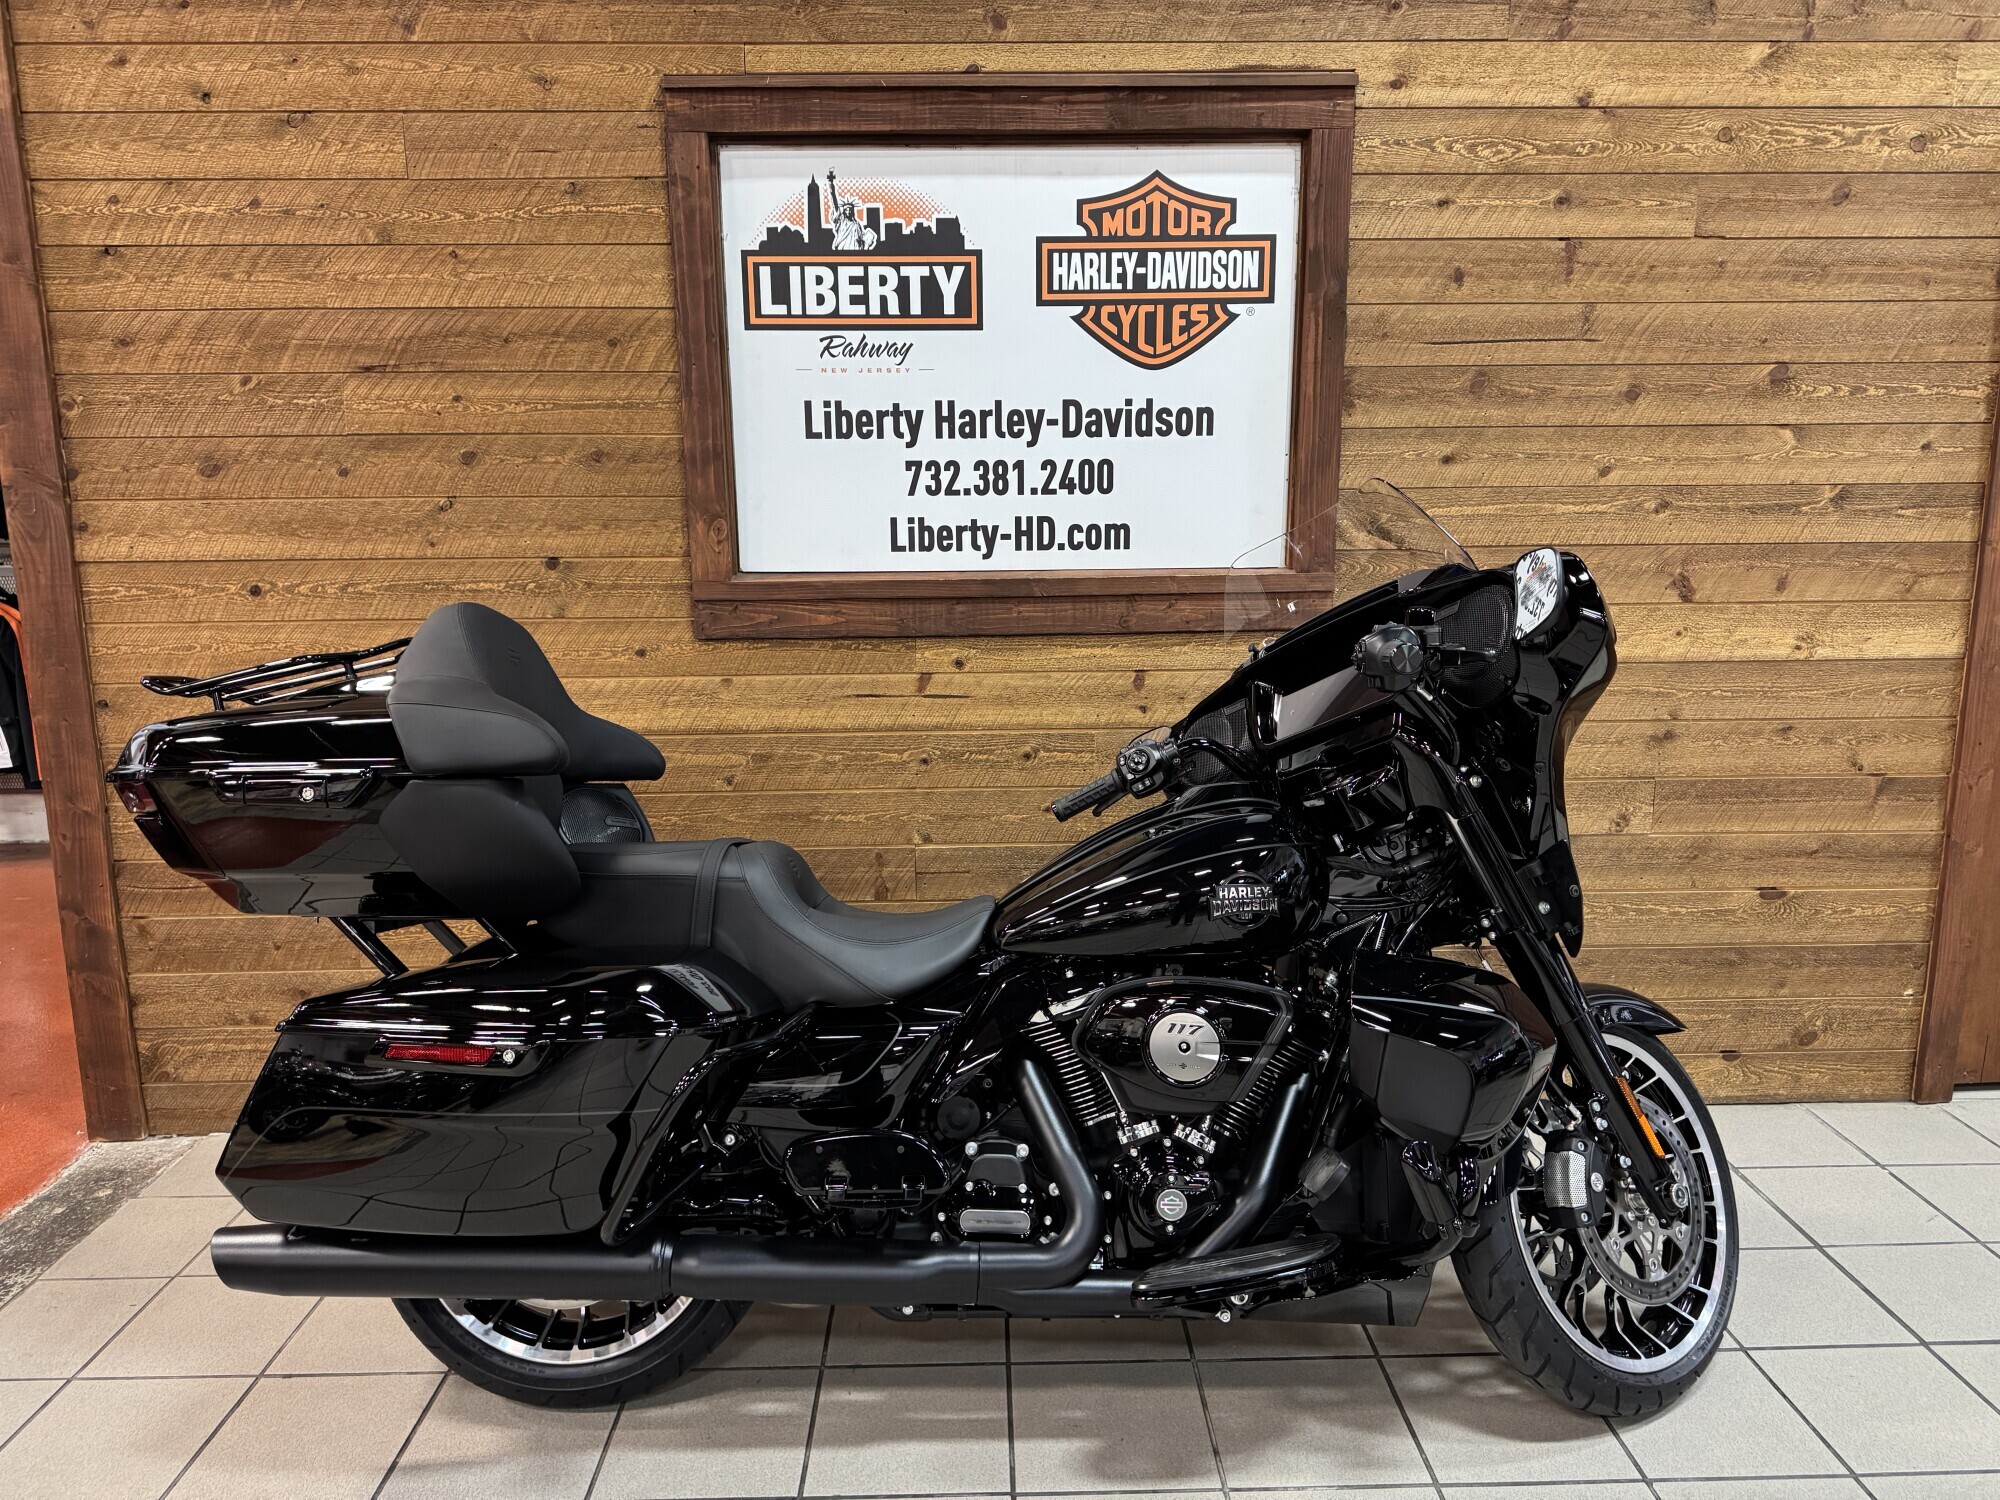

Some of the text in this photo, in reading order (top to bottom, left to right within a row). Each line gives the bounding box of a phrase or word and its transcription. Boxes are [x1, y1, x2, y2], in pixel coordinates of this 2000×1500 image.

[1102, 190, 1212, 237] MOTOR
[758, 265, 966, 316] LIBERTY
[1052, 249, 1260, 291] HARLEY-DAVIDSON
[819, 333, 914, 367] Rahway
[1100, 303, 1209, 355] CYCLES
[803, 398, 1215, 449] Liberty Harley-Davidson
[904, 458, 1114, 497] 732.381.2400
[889, 515, 1131, 561] Liberty-HD.com
[1212, 898, 1279, 917] DAVIDSON
[1167, 1022, 1205, 1036] 117
